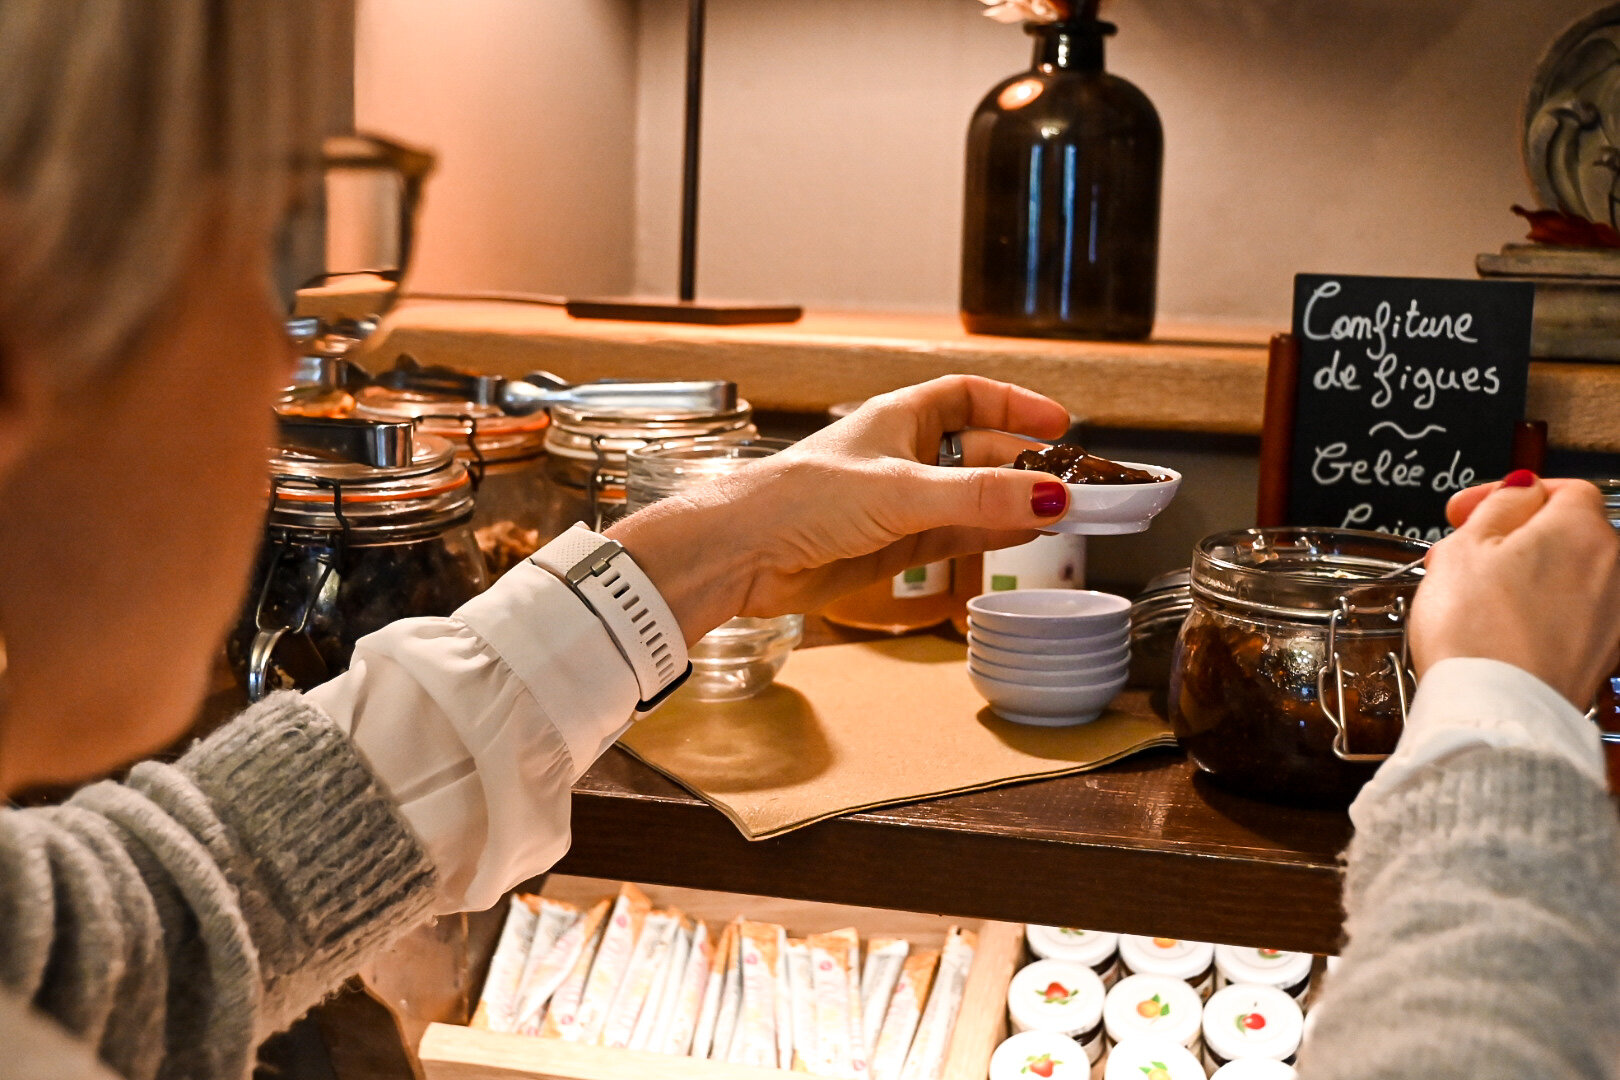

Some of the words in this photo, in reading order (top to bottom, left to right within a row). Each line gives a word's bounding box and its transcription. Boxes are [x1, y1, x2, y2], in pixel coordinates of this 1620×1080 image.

[1313, 350, 1361, 390] de
[1371, 353, 1500, 408] figues
[1311, 442, 1425, 487] Gelée
[1431, 449, 1475, 492] de
